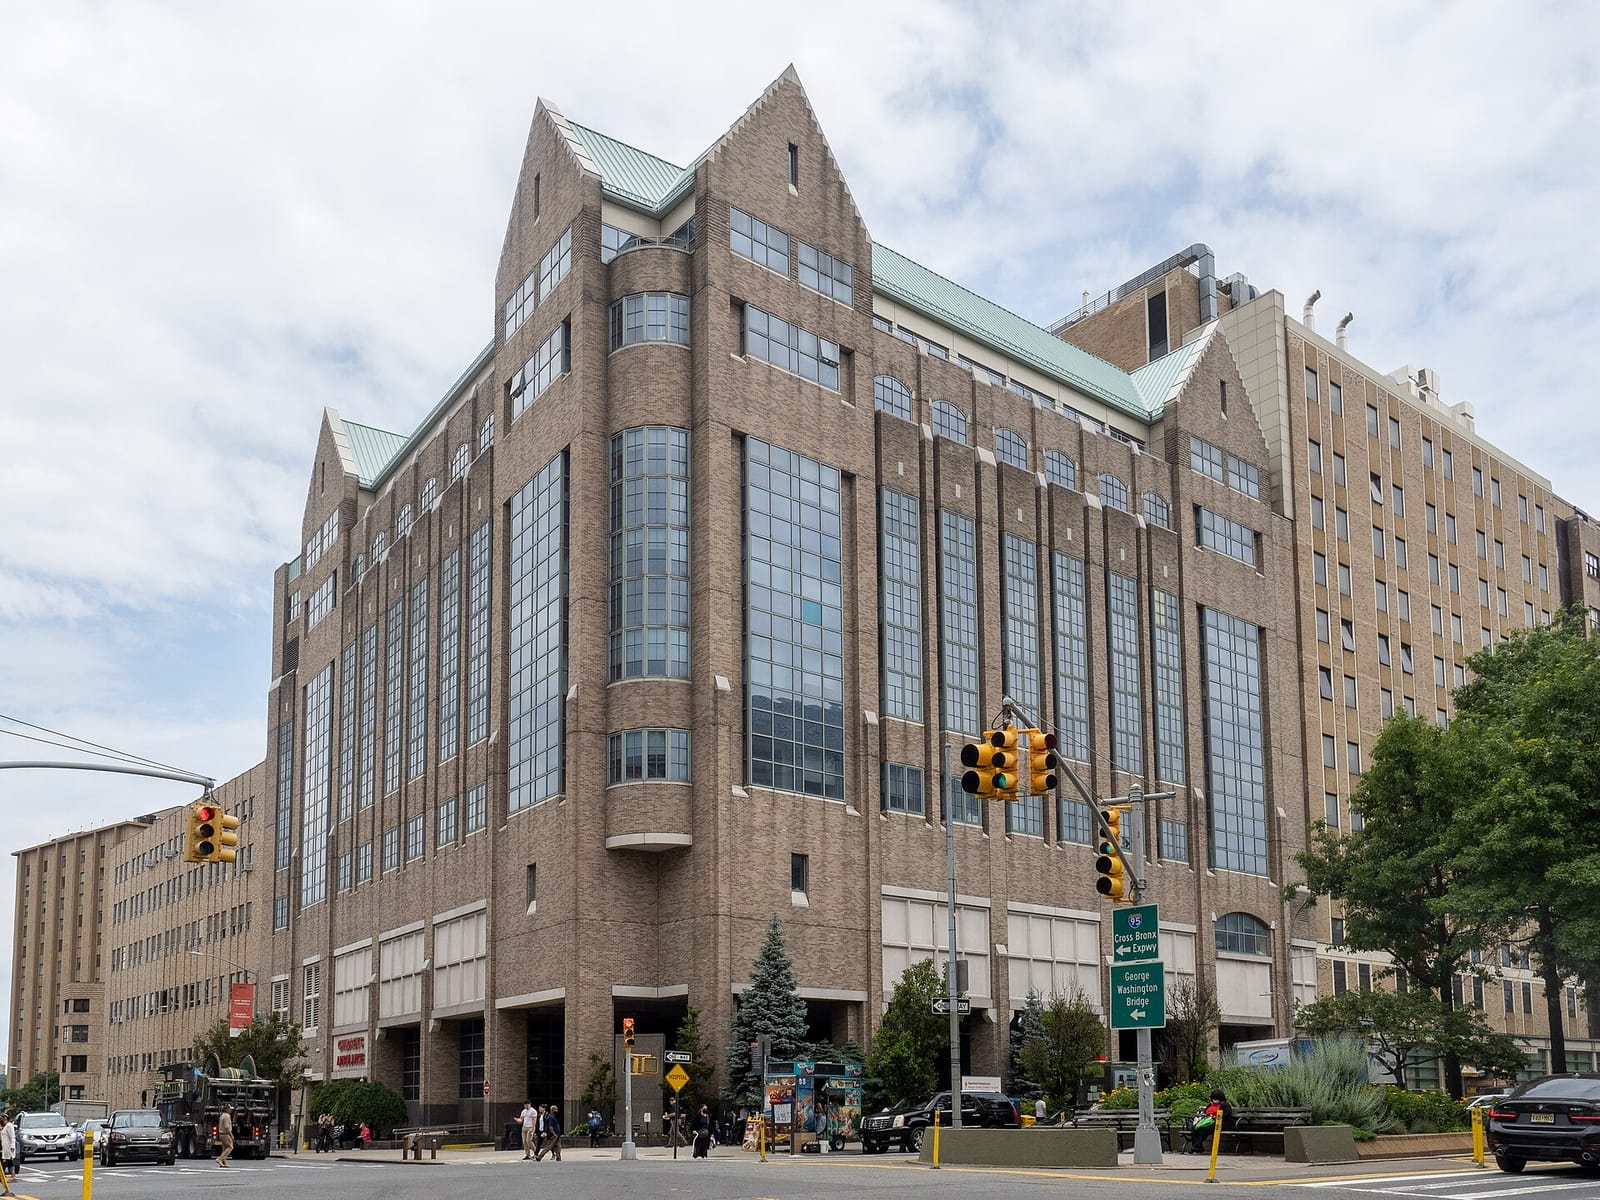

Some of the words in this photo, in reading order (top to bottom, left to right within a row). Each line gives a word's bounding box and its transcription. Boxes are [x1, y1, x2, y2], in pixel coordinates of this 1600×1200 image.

[1130, 917, 1141, 926] 95
[1114, 934, 1134, 943] Cross
[1135, 931, 1157, 941] Bronx
[1132, 943, 1157, 954] Expwy
[1124, 971, 1150, 982] George
[1117, 983, 1158, 995] Washington
[1126, 996, 1150, 1008] Bridge
